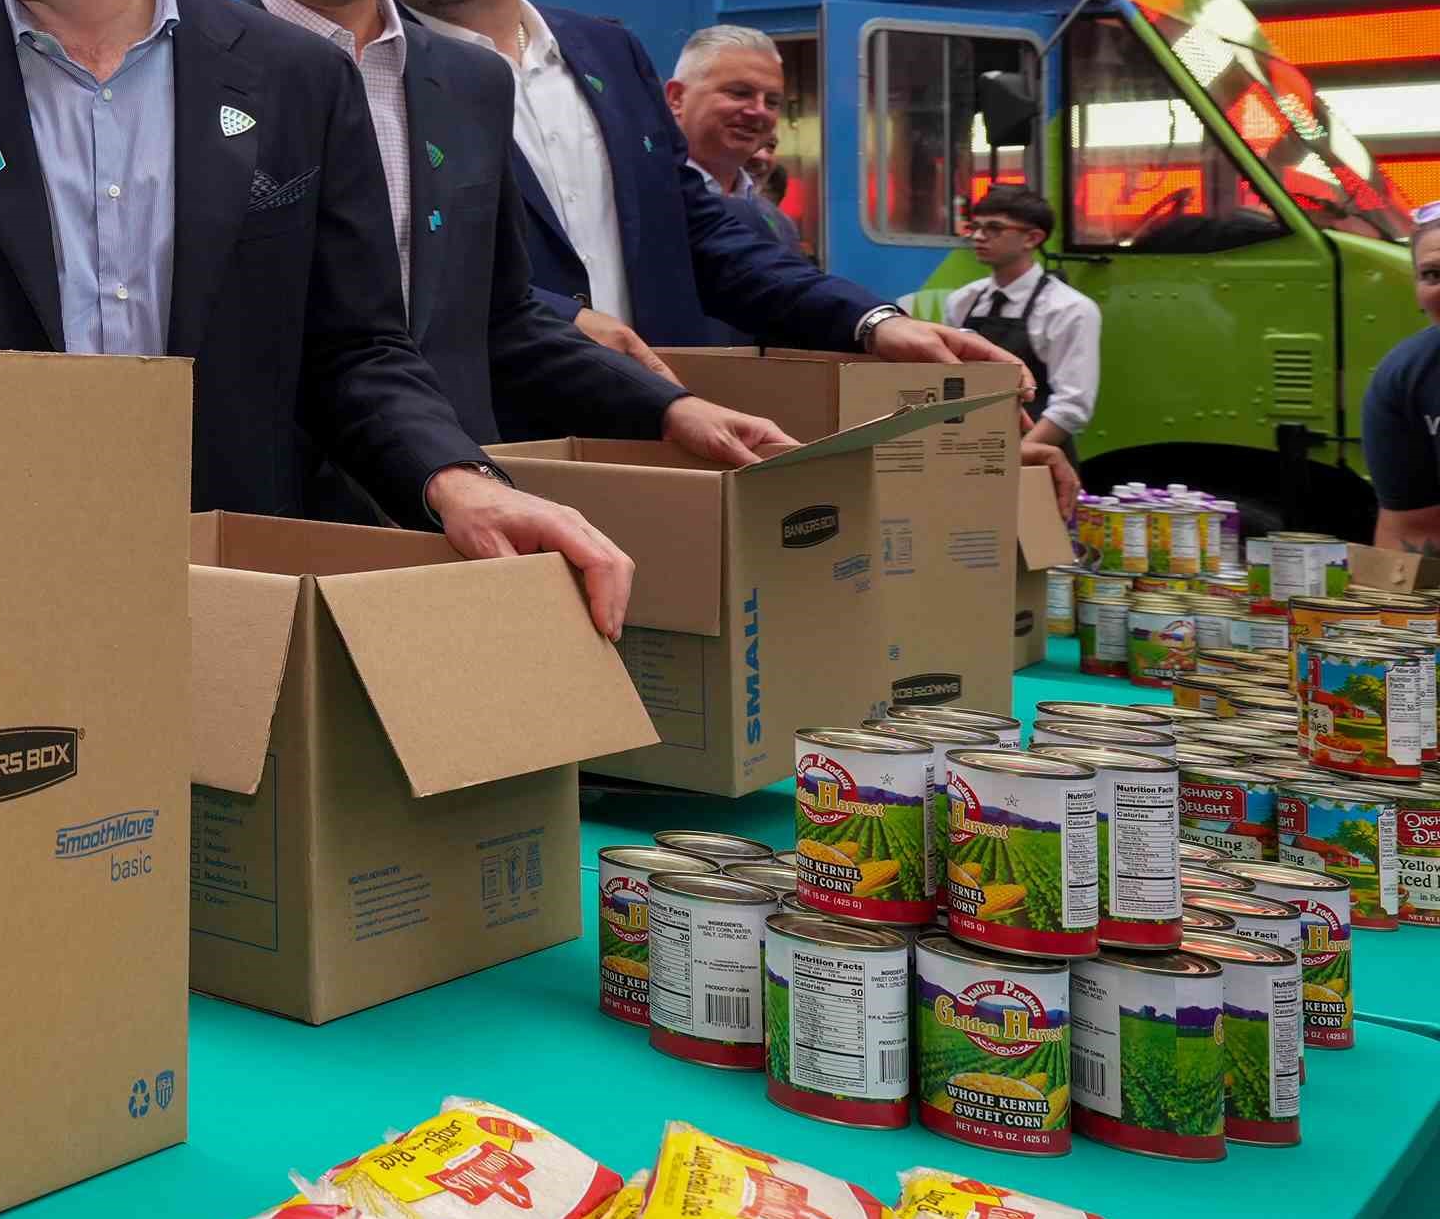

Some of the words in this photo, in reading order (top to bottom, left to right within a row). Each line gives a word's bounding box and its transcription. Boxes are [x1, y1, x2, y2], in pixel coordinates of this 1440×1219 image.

[744, 587, 762, 745] SMALL
[26, 743, 70, 770] BOX
[818, 755, 852, 790] Products
[818, 781, 886, 817] Harvest
[1116, 785, 1156, 794] Nutrition
[1116, 811, 1149, 819] Calories
[56, 816, 154, 855] SmoothMove
[1204, 835, 1243, 852] Cling
[111, 847, 152, 882] basic
[815, 862, 861, 880] KERNEL
[820, 877, 852, 892] CORN
[952, 900, 976, 914] CORN
[1307, 899, 1338, 930] Products
[1255, 931, 1278, 940] Facts
[794, 952, 834, 968] Nutrition
[837, 960, 863, 972] Facts
[795, 979, 825, 992] Calories
[850, 988, 863, 997] 30
[956, 983, 996, 1007] Quality
[1002, 979, 1041, 1018] Products
[935, 994, 1000, 1038] Golden
[1003, 1009, 1065, 1043] Harvest
[1305, 1001, 1346, 1014] KERNEL
[1310, 1015, 1341, 1027] CORN
[947, 1085, 995, 1106] WHOLE
[999, 1095, 1049, 1113] KERNEL
[955, 1103, 1002, 1123] SWEET
[1005, 1114, 1041, 1128] CORN
[956, 1121, 971, 1131] NET
[974, 1125, 991, 1137] WT.
[993, 1130, 1003, 1140] 15
[1005, 1132, 1020, 1142] OZ.
[1023, 1133, 1040, 1144] (425
